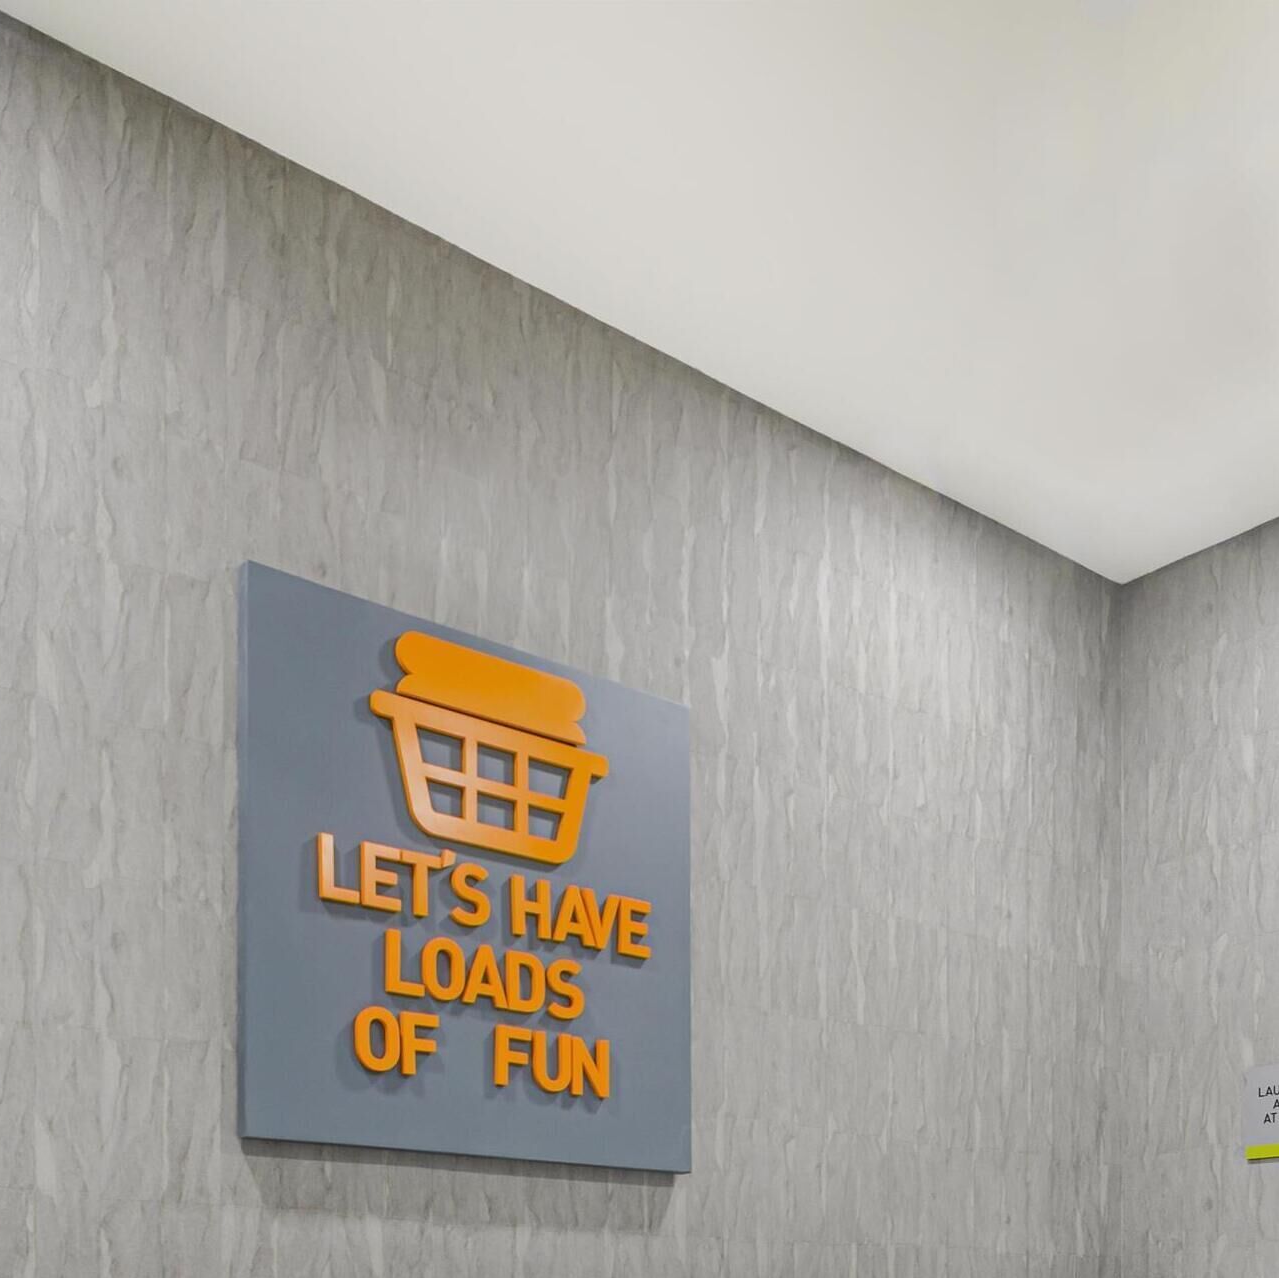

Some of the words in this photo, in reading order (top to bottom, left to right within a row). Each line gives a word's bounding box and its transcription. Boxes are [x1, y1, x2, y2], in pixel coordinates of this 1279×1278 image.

[318, 832, 491, 928] LET'S
[510, 874, 652, 959] HAVE
[384, 928, 586, 1022] LOADS
[353, 1004, 440, 1076] OF
[494, 1023, 611, 1099] FUN
[1263, 1112, 1278, 1125] AT
